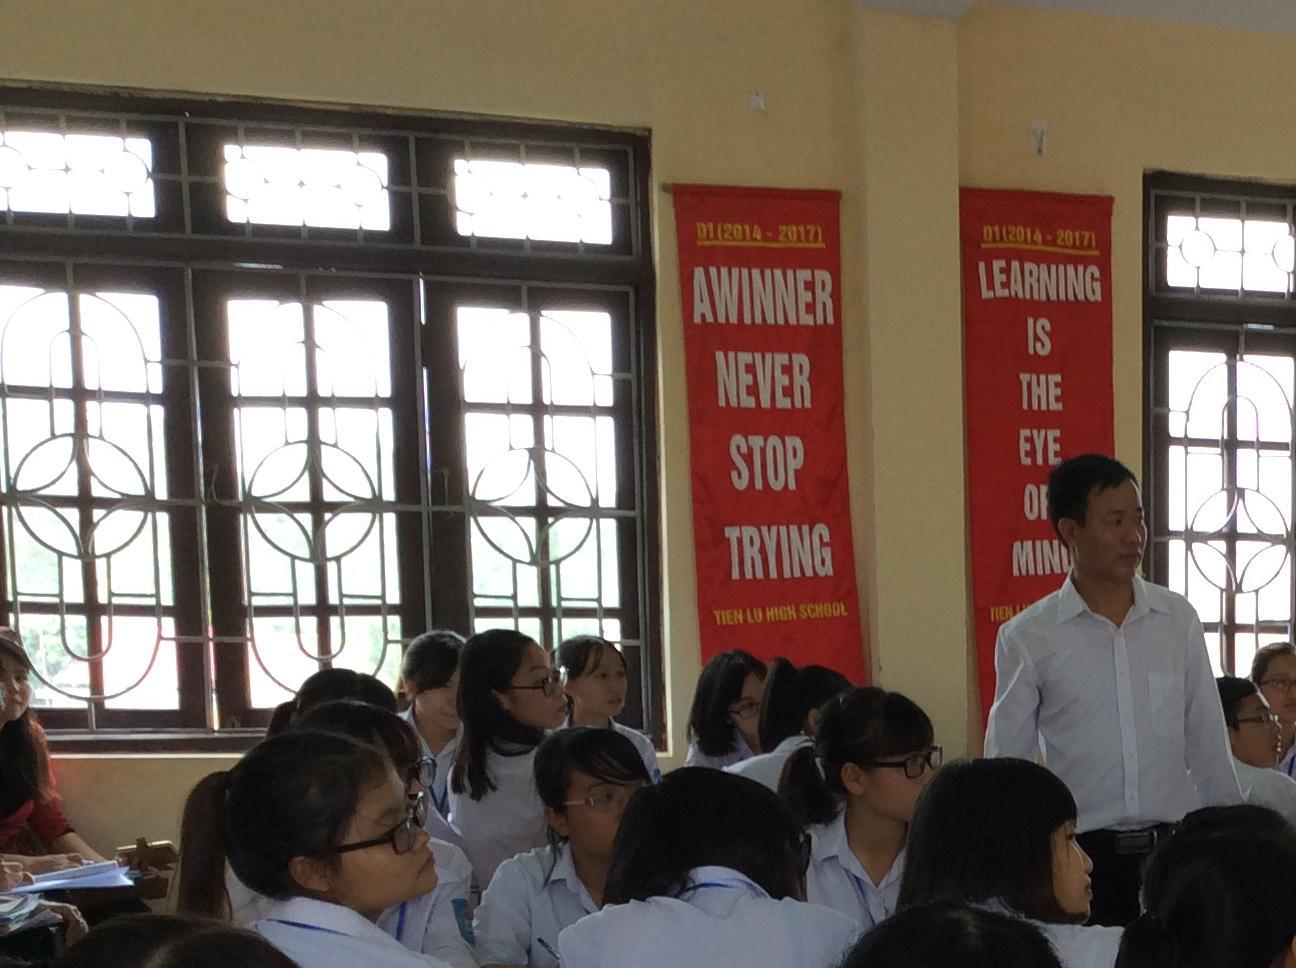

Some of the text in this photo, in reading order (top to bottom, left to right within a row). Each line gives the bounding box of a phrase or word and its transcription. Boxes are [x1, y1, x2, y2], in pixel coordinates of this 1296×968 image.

[978, 259, 1102, 302] LEARNING
[1026, 317, 1051, 356] IS
[715, 351, 812, 409] NEVER
[1019, 373, 1063, 411] THE
[729, 434, 804, 491] STOP
[1019, 429, 1062, 466] EYE
[724, 523, 834, 580] TRYING
[714, 608, 744, 626] TIEN
[766, 605, 797, 621] HIGH
[800, 601, 848, 619] SCHOOL
